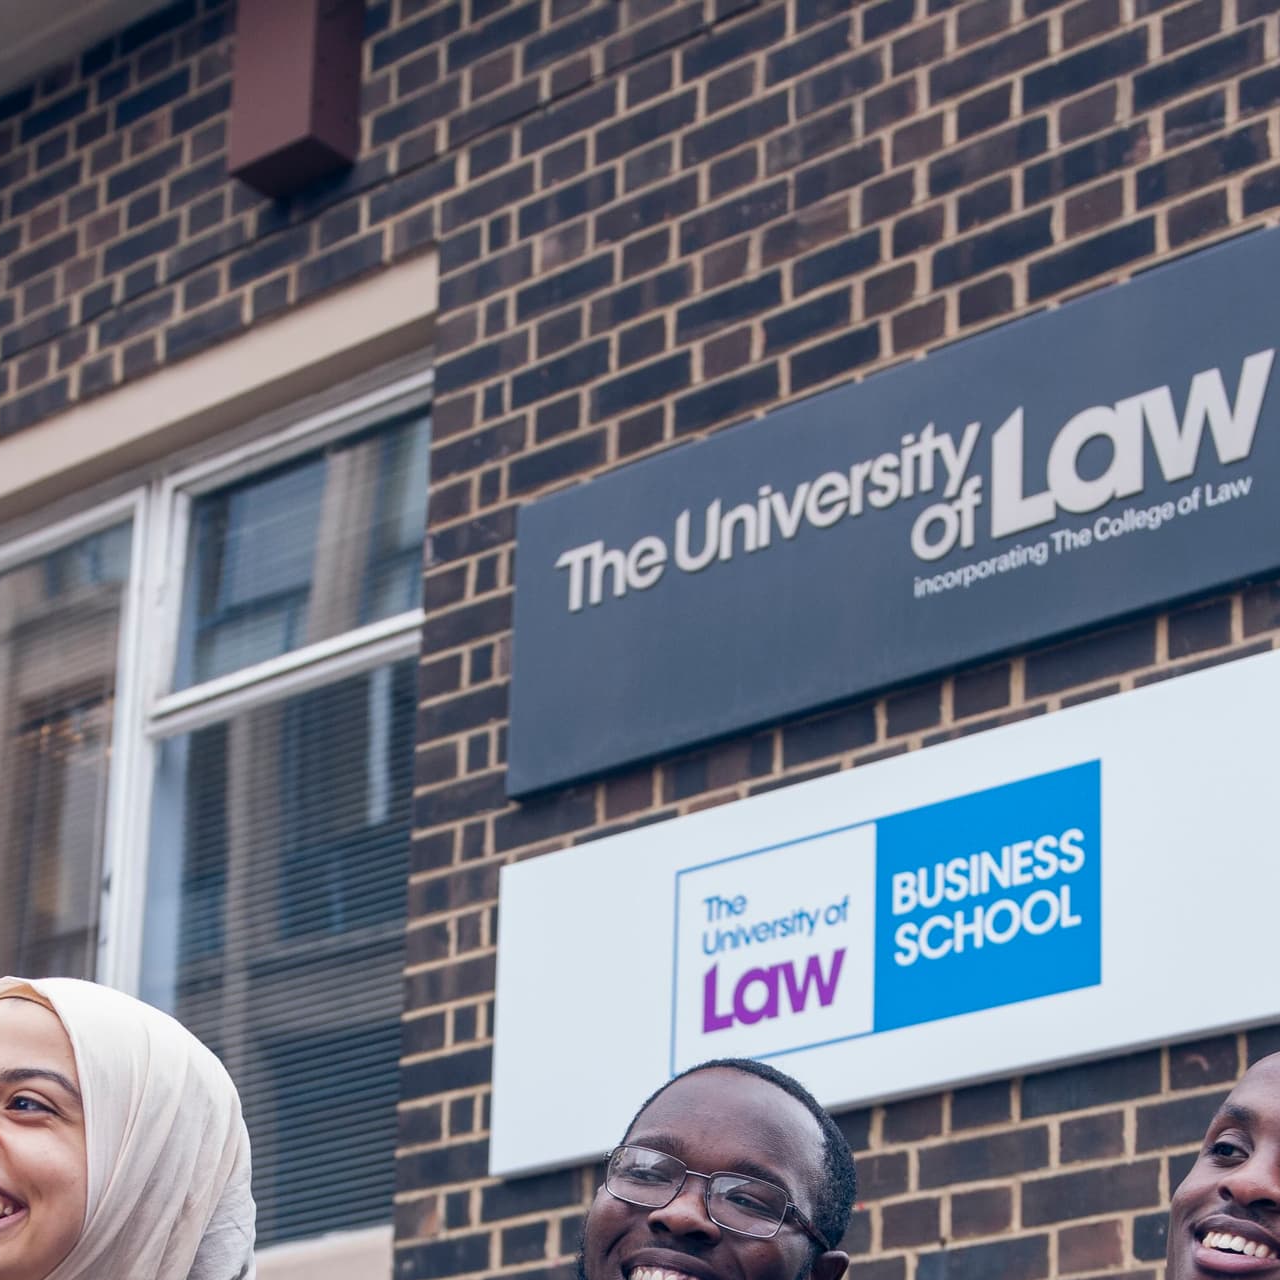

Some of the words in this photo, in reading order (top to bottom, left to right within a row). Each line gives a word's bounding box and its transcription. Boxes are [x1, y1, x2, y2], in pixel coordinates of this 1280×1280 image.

[911, 475, 982, 561] of
[991, 349, 1275, 539] Law
[554, 536, 667, 612] The
[675, 421, 981, 572] University
[913, 540, 1049, 598] incorporating
[1050, 526, 1092, 555] The
[1093, 499, 1175, 542] College
[1177, 489, 1200, 515] of
[1205, 476, 1253, 507] Law
[704, 894, 748, 922] The
[892, 828, 1086, 916] BUSINESS
[703, 907, 820, 955] University
[824, 893, 850, 926] of
[894, 884, 1082, 967] SCHOOL
[702, 947, 847, 1034] Law
